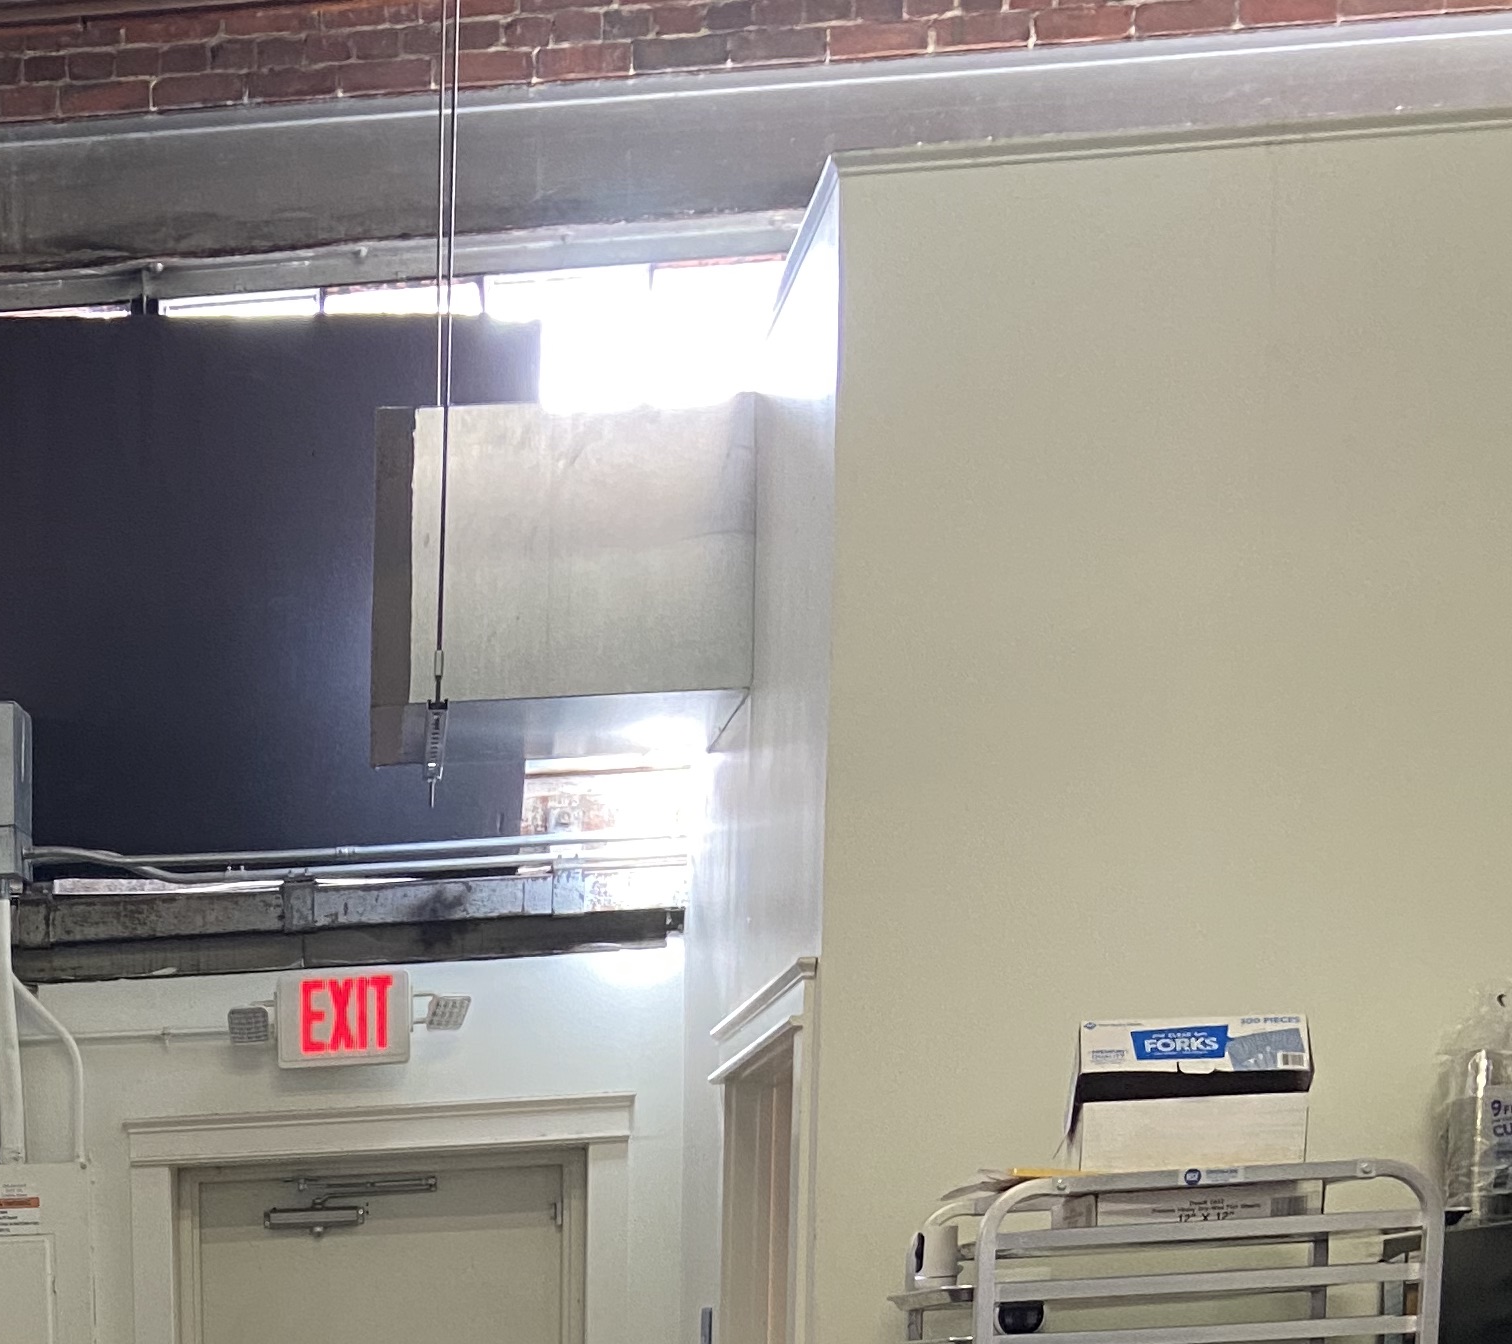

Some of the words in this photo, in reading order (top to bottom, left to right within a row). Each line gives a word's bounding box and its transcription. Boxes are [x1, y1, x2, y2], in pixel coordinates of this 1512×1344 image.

[300, 975, 393, 1053] EXIT
[1263, 1015, 1301, 1024] PIECES
[1144, 1035, 1220, 1054] FORKS
